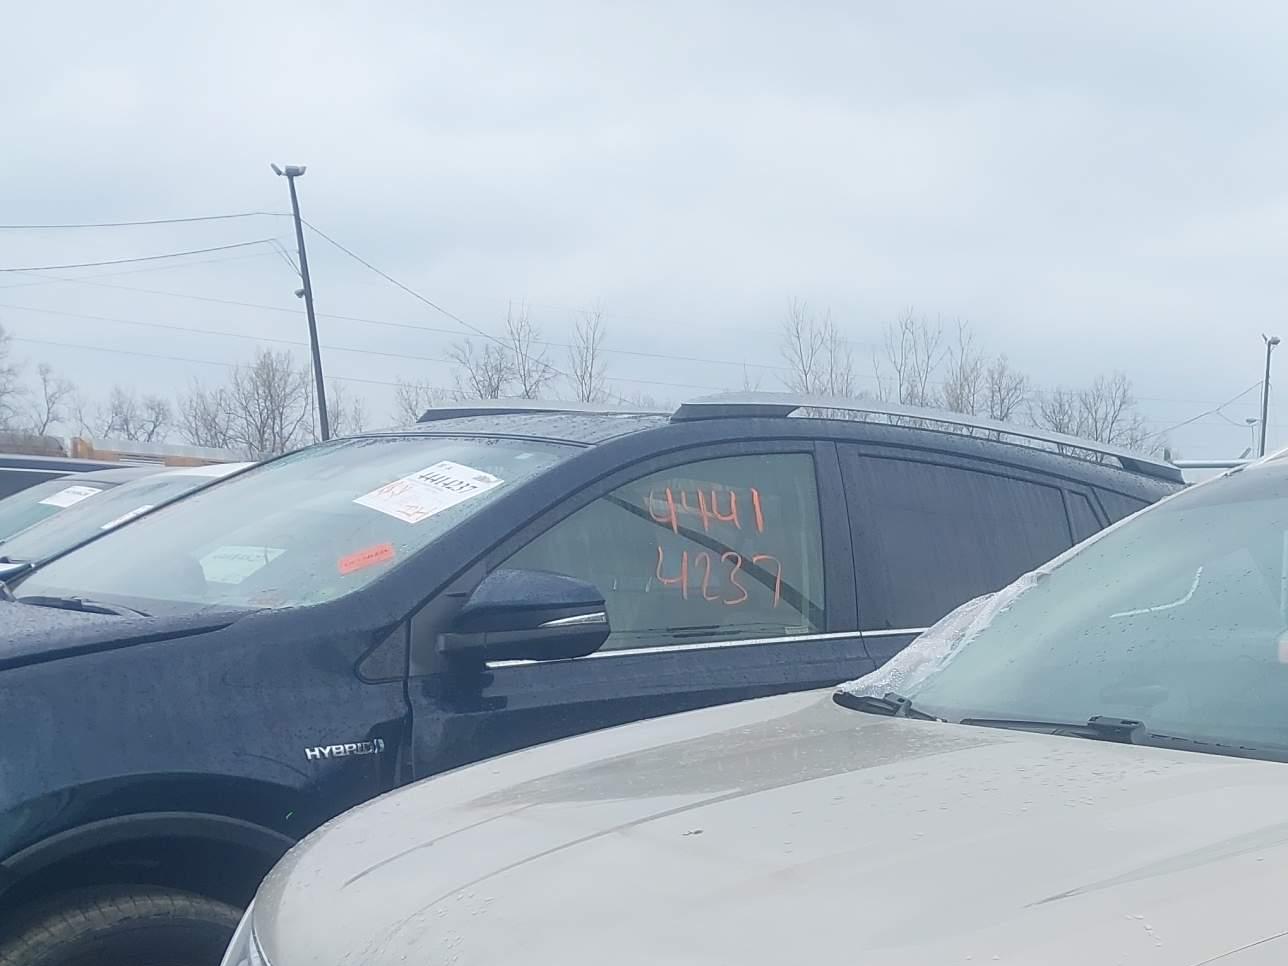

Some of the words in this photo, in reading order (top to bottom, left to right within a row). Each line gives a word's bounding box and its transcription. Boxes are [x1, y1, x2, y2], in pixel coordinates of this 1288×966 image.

[648, 486, 765, 535] 4441
[656, 545, 783, 609] 4237
[304, 741, 374, 760] HYBRID
